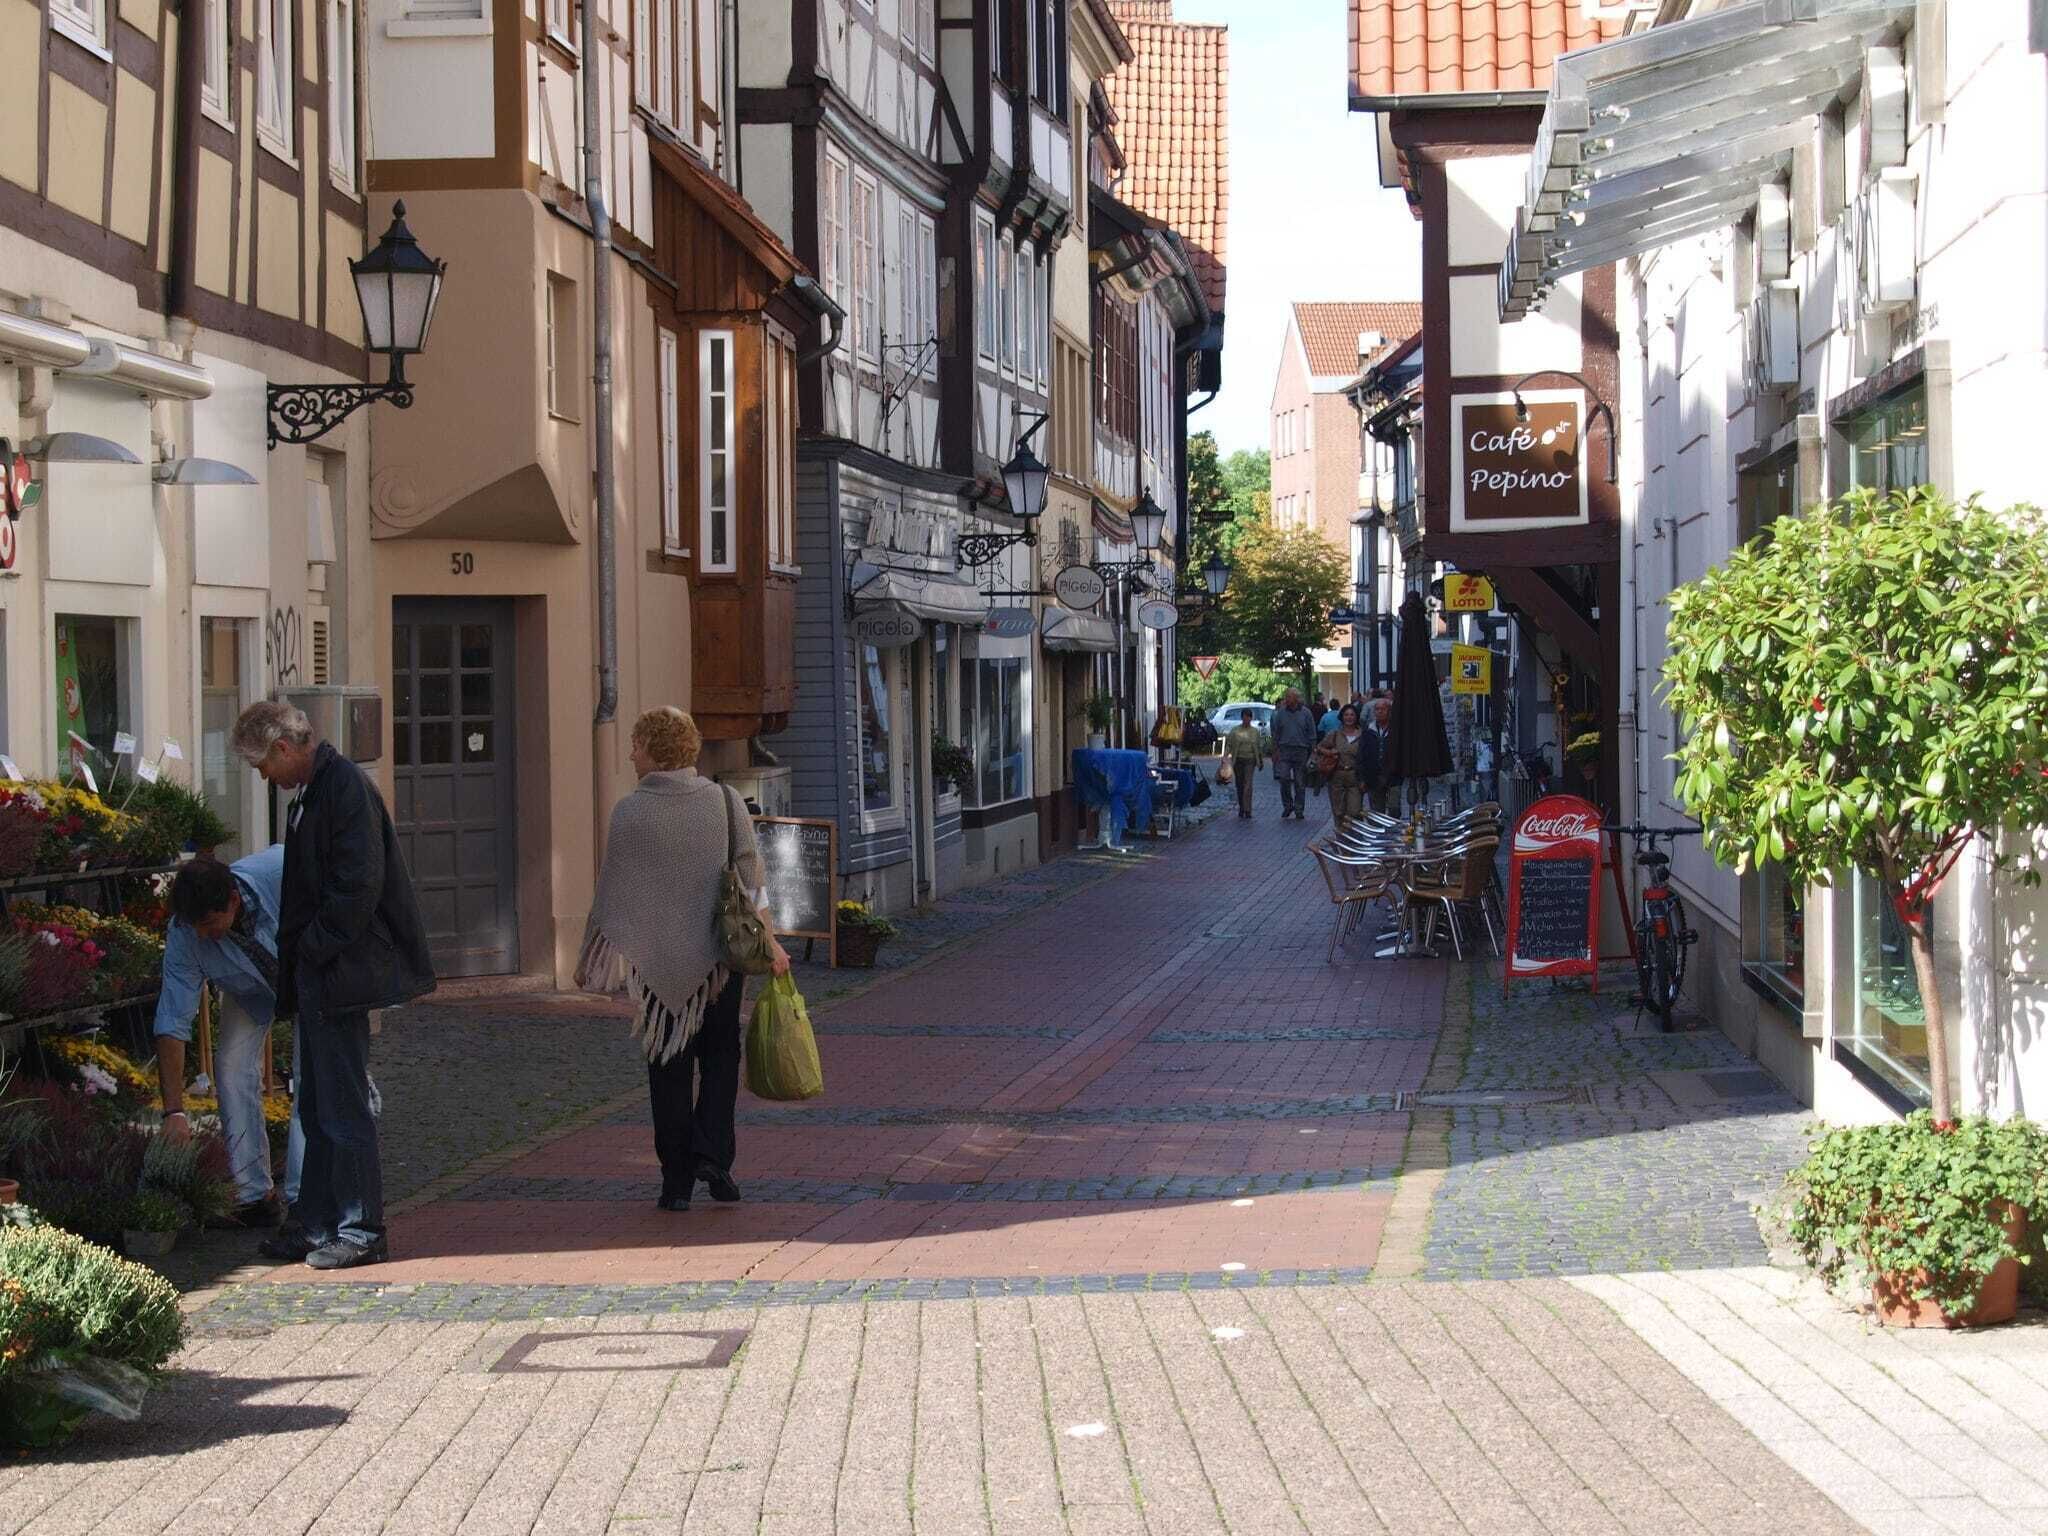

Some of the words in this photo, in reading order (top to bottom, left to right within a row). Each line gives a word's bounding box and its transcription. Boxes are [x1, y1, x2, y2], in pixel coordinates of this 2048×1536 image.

[1471, 427, 1538, 456] Café
[1471, 469, 1572, 496] Pepino
[451, 552, 474, 575] 50
[1452, 598, 1486, 608] LOTTO
